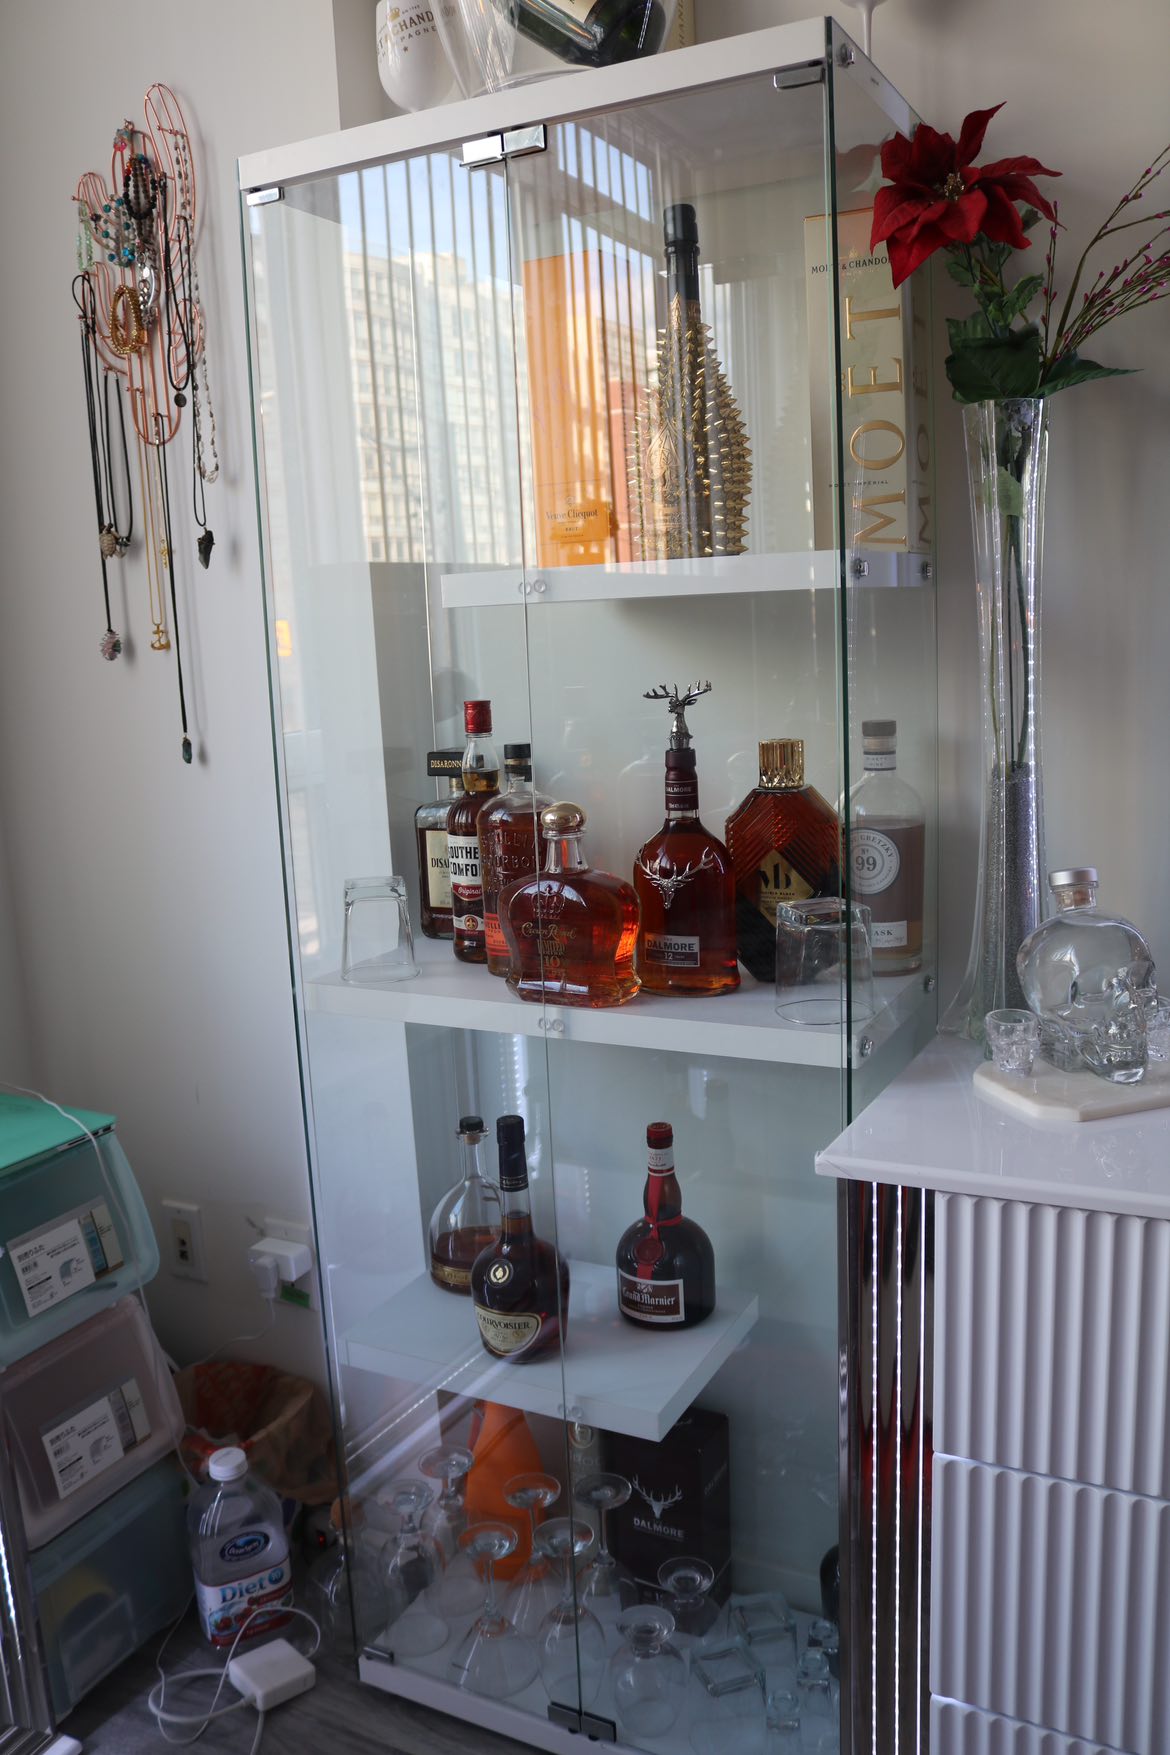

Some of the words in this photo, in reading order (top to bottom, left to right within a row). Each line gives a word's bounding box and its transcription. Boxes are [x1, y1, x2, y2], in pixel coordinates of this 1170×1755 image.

[567, 508, 599, 521] Clicquot
[430, 759, 463, 769] DISARONN
[448, 845, 480, 860] OUTHE
[855, 855, 877, 872] 99
[457, 885, 483, 897] Original
[873, 928, 894, 937] ASK
[647, 940, 697, 952] DALMORE
[663, 952, 674, 961] 12
[641, 1291, 677, 1307] Marnier
[633, 1517, 684, 1539] DALMORE
[219, 1576, 267, 1604] Diet
